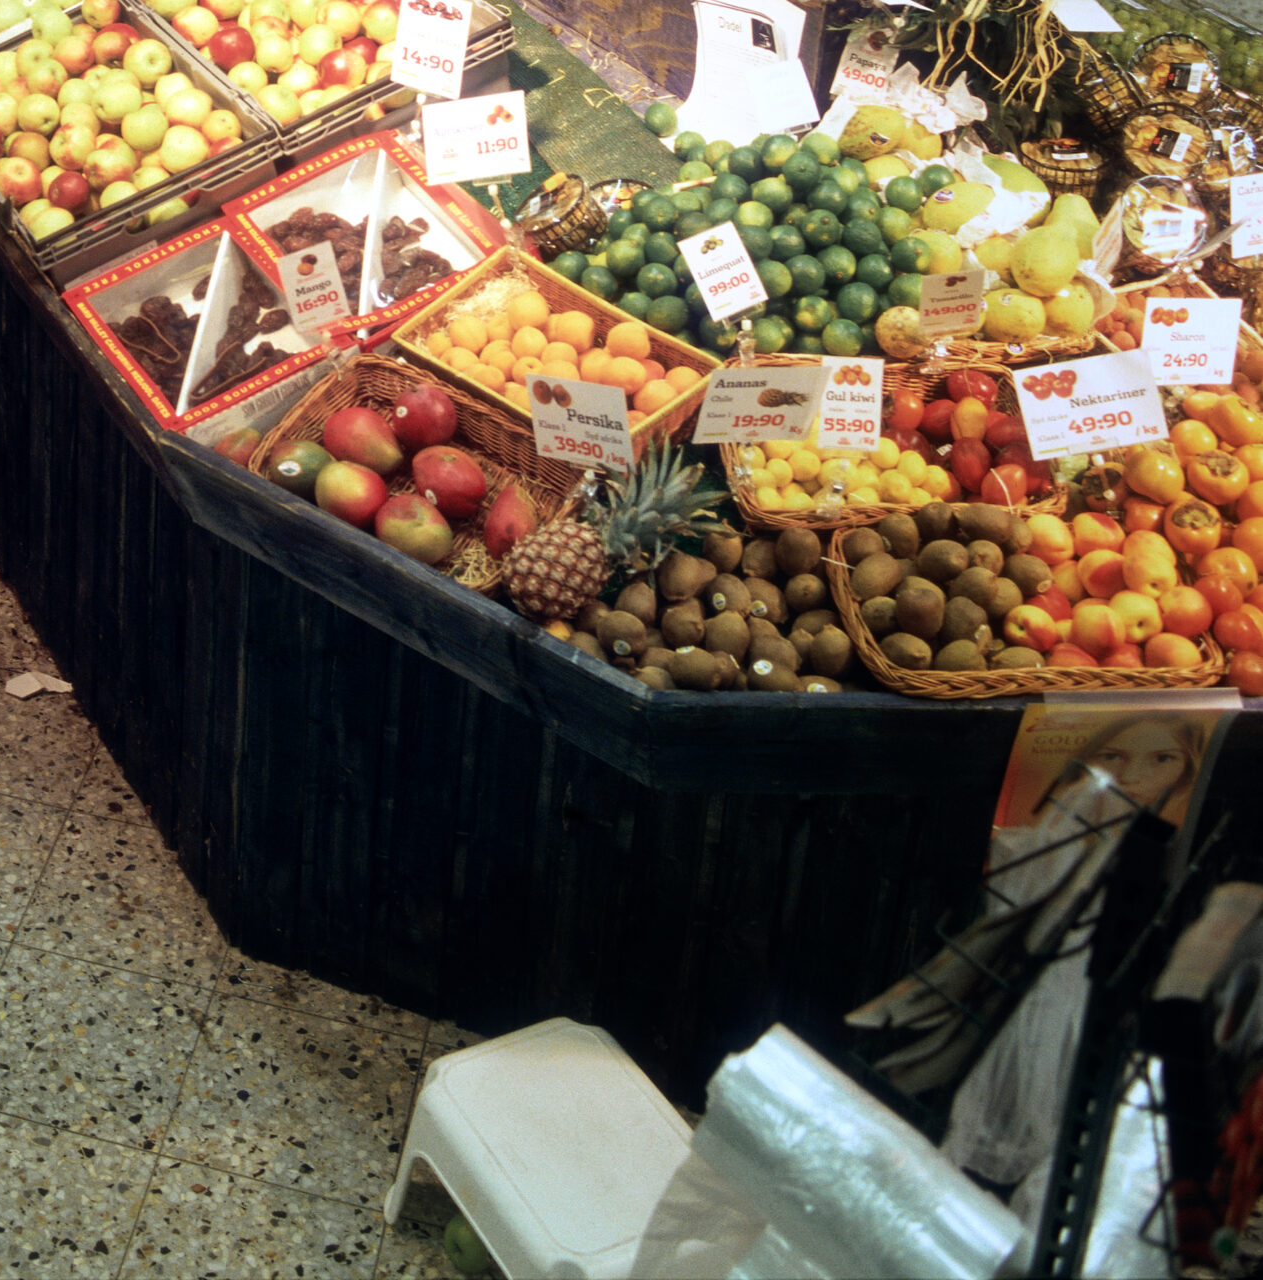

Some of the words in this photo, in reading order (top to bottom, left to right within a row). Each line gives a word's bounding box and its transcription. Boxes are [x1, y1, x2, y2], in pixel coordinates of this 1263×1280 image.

[401, 47, 455, 74] 14:90
[842, 66, 887, 88] 49:00
[476, 136, 519, 154] 11:90
[281, 138, 376, 183] CHOLESTEROL
[124, 224, 221, 273] CHOLESTEROL
[83, 273, 119, 293] FREE
[295, 280, 332, 297] Mango
[708, 272, 750, 297] 99:00
[296, 290, 339, 314] 16:90
[342, 315, 378, 328] GOOD
[382, 293, 432, 318] SOURCE
[435, 282, 450, 293] OF
[923, 303, 977, 317] 149:00
[1162, 353, 1209, 368] 24:90
[183, 402, 219, 421] GOOD
[222, 375, 270, 402] SOURCE
[274, 364, 288, 376] OF
[293, 348, 325, 366] FIBE
[714, 379, 767, 389] Ananas
[825, 390, 846, 402] Gul
[849, 391, 876, 403] kiwi
[1069, 387, 1147, 409] Nektariner
[566, 408, 625, 431] Persika
[732, 413, 785, 428] 19:90
[824, 417, 875, 433] 55:90
[1068, 410, 1132, 434] 49:90
[554, 435, 604, 459] 39:90
